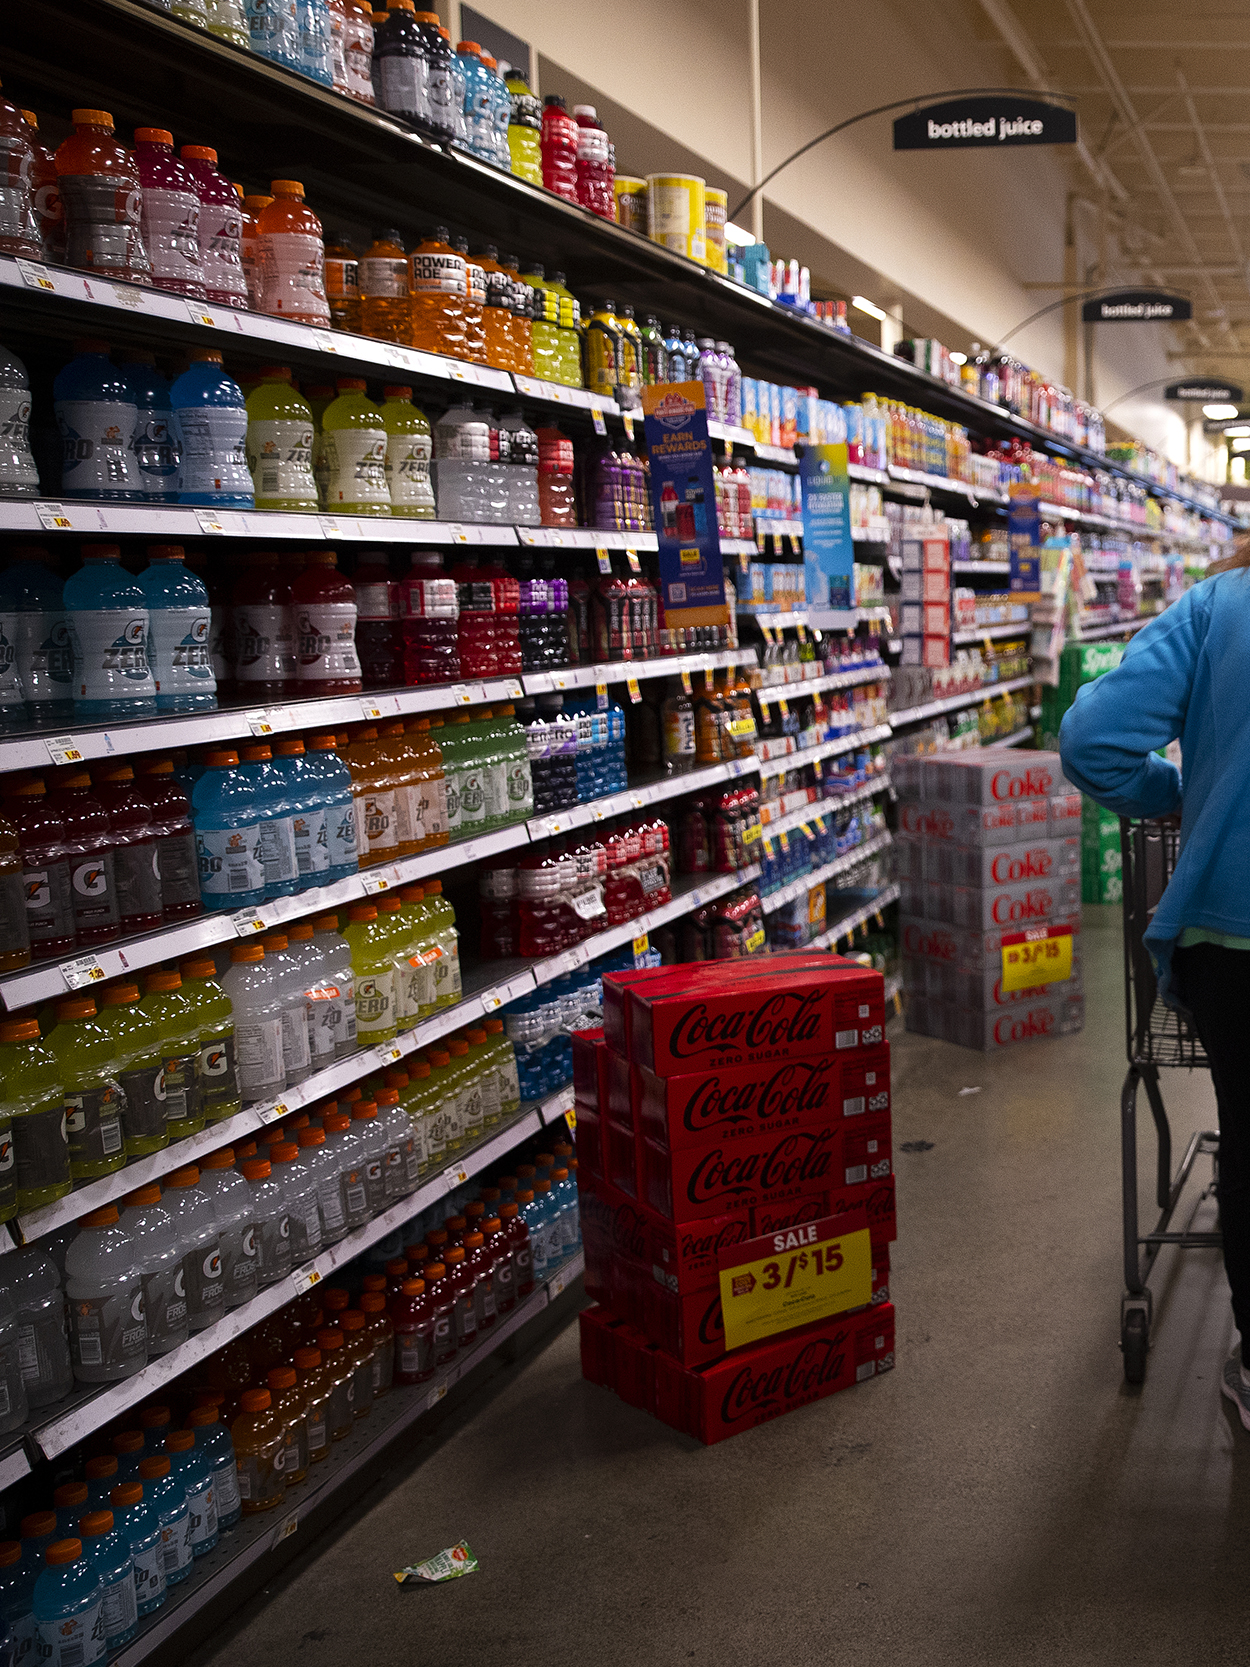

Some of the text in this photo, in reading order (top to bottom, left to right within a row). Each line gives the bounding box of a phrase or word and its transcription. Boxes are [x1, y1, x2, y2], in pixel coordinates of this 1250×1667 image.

[928, 116, 1044, 140] bottled juice
[413, 255, 462, 270] POWER
[414, 268, 441, 280] ADE
[1101, 302, 1174, 319] bottled juice
[145, 419, 169, 443] G
[662, 431, 694, 443] EARN
[651, 440, 708, 454] REWARDS
[124, 618, 149, 645] G
[189, 616, 210, 643] G
[990, 769, 1053, 801] Coke
[72, 860, 108, 897] G
[991, 852, 1052, 885] Coke
[23, 871, 51, 908] G
[991, 891, 1052, 925] Coke
[669, 988, 830, 1058] Coca-Cola
[993, 1008, 1054, 1046] Coke
[202, 1043, 228, 1077] G
[709, 1048, 790, 1067] ZERO SUGAR
[683, 1057, 837, 1132] Coca-Cola
[722, 1117, 800, 1139] ZERO SUGAR
[687, 1127, 839, 1204] Coca-Cola
[762, 1187, 802, 1201] SUGAR
[773, 1225, 818, 1252] SALE
[203, 1248, 222, 1278] G
[762, 1244, 844, 1290] 3/$15
[721, 1330, 850, 1423] Coca-Cola
